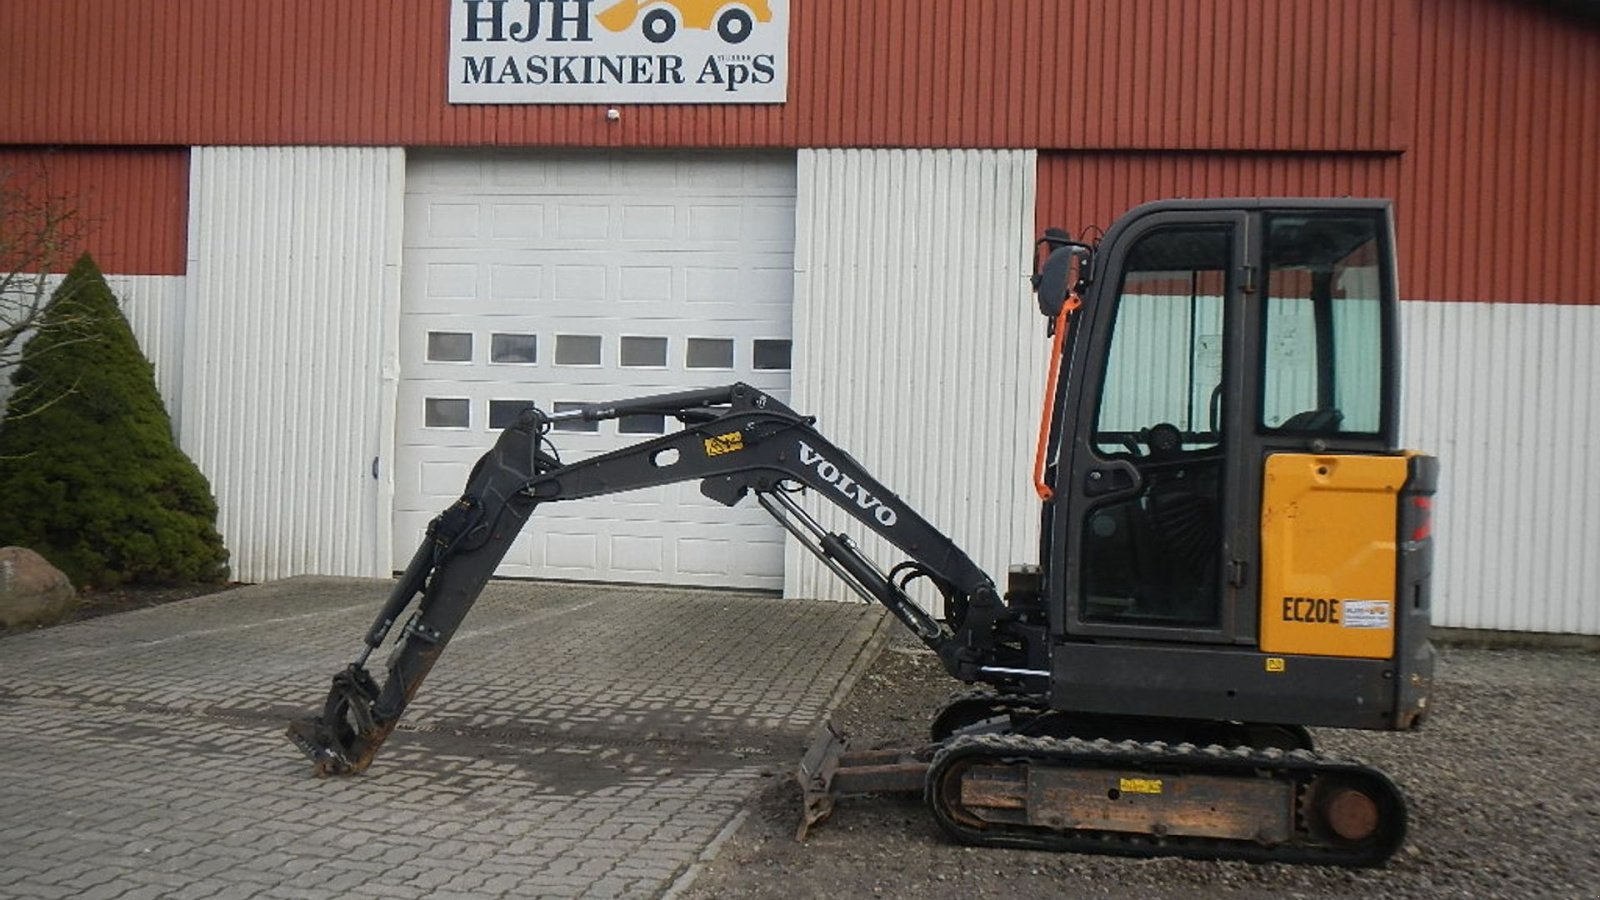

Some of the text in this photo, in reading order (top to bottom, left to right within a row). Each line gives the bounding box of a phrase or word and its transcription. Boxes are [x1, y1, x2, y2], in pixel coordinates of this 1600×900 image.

[461, 0, 593, 43] HJH
[462, 54, 775, 92] MASKINER ApS
[798, 441, 898, 527] VOLVO
[1282, 597, 1340, 624] EC20E
